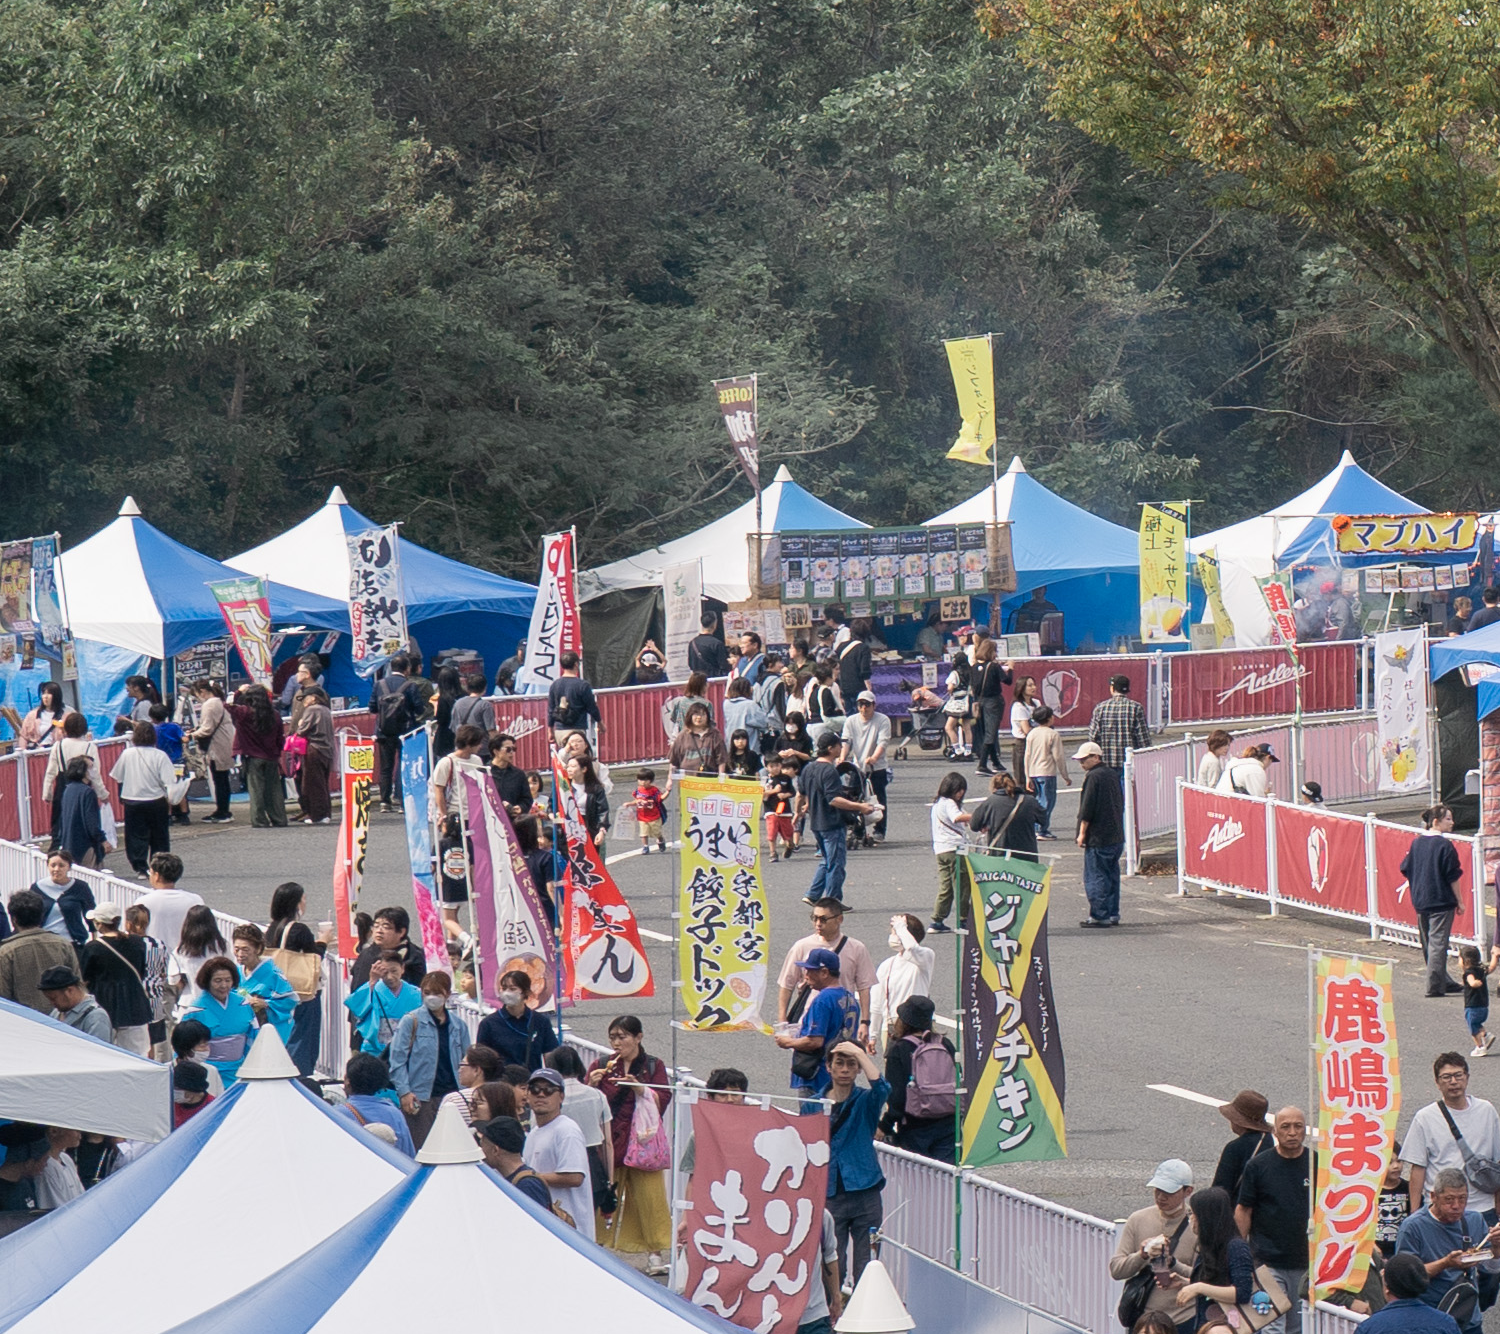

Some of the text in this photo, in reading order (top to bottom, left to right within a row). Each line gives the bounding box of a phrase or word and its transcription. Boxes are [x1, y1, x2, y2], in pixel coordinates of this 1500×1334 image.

[1352, 518, 1465, 547] マブハイ
[942, 599, 969, 619] ご注文
[1216, 662, 1313, 704] Antlers
[684, 816, 753, 860] うまい
[1200, 816, 1245, 861] Antlers
[1015, 875, 1044, 894] TASTE
[731, 868, 766, 963] 宇都宮
[984, 891, 1033, 1150] ジャークチキン
[1321, 975, 1390, 1287] 鹿嶋まつり
[691, 1169, 759, 1318] まん
